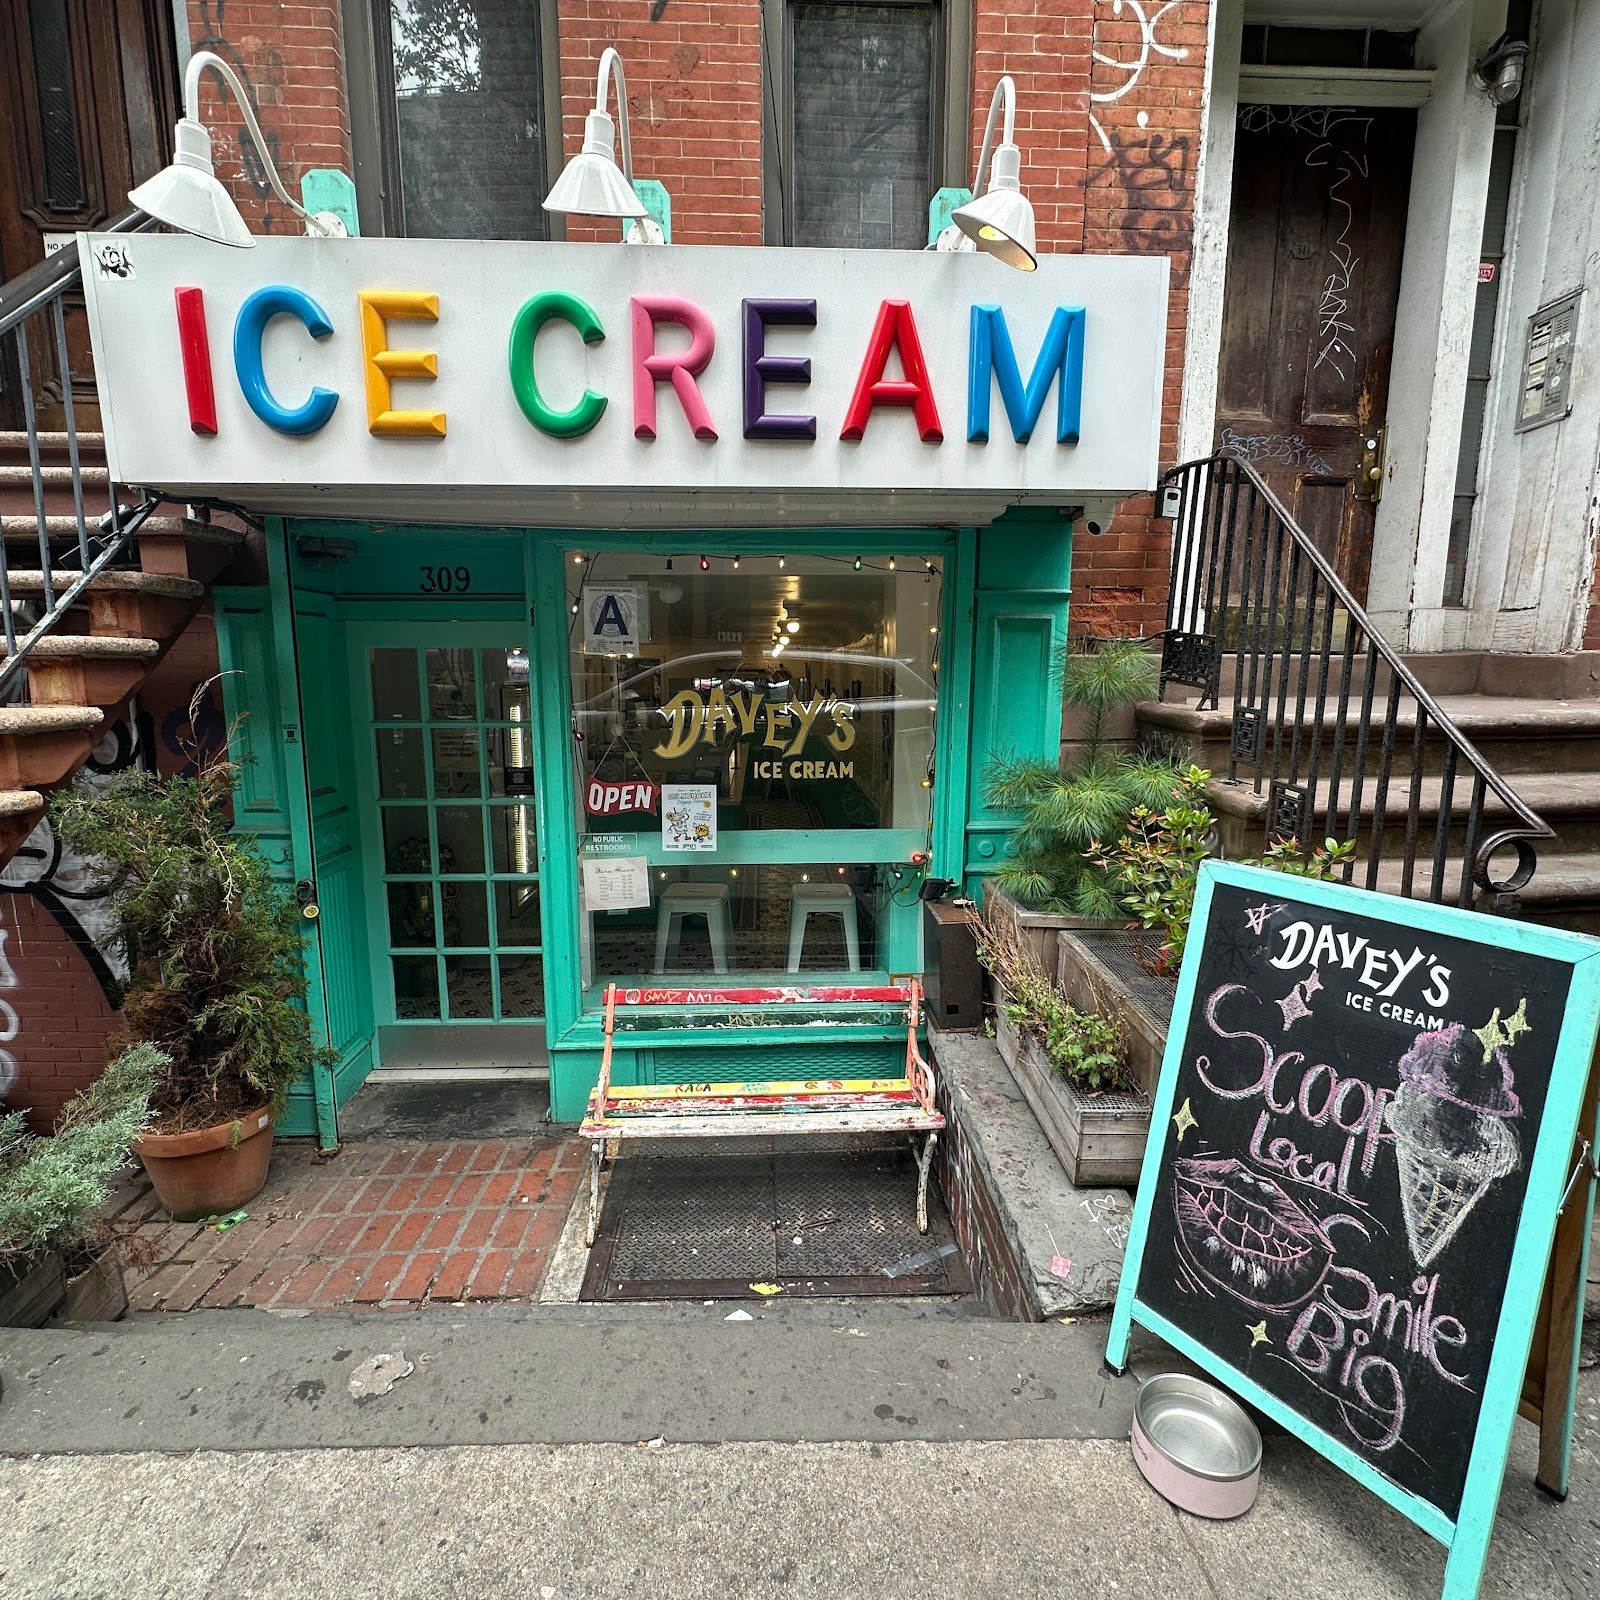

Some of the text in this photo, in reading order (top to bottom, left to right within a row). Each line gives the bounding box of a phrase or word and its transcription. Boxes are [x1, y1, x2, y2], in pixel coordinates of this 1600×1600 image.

[174, 285, 1086, 446] ICE CREAM
[419, 566, 472, 593] 309
[593, 595, 629, 636] A
[654, 688, 856, 759] DAVEY'S
[753, 760, 854, 779] ICE CREAM
[588, 783, 653, 812] OPEN
[585, 844, 632, 852] RESTROOMS
[603, 835, 624, 843] PUBLIC
[1269, 921, 1452, 1008] DAVEY'S
[1345, 991, 1445, 1032] ICE CREAM
[1250, 1109, 1369, 1207] Local
[1317, 1213, 1477, 1394] Smile
[1286, 1301, 1407, 1452] Big
